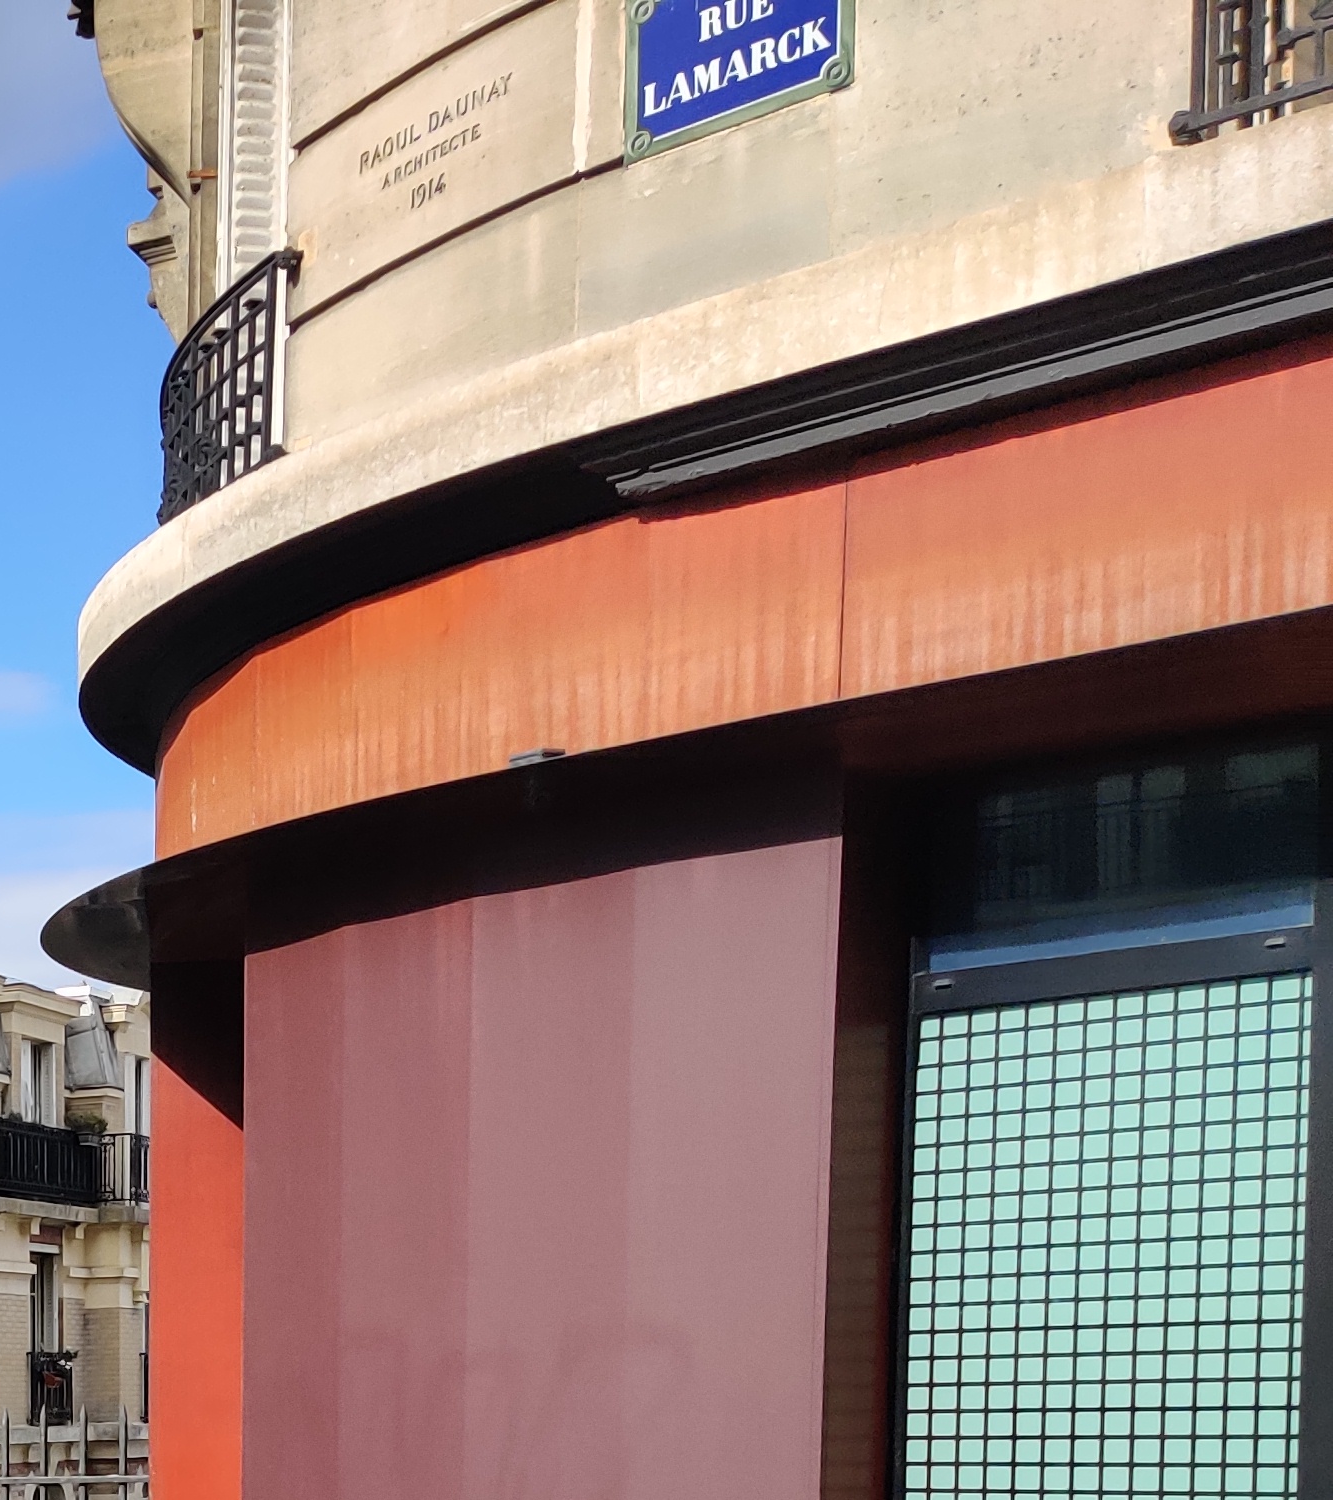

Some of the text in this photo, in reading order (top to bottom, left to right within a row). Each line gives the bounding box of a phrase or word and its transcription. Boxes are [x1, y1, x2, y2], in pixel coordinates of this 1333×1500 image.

[698, 0, 774, 43] RUE
[643, 16, 831, 118] LAMARCK
[358, 71, 513, 175] RAOUL DAUNAY
[381, 122, 482, 191] ARCHITECTE
[410, 171, 447, 210] 1914
